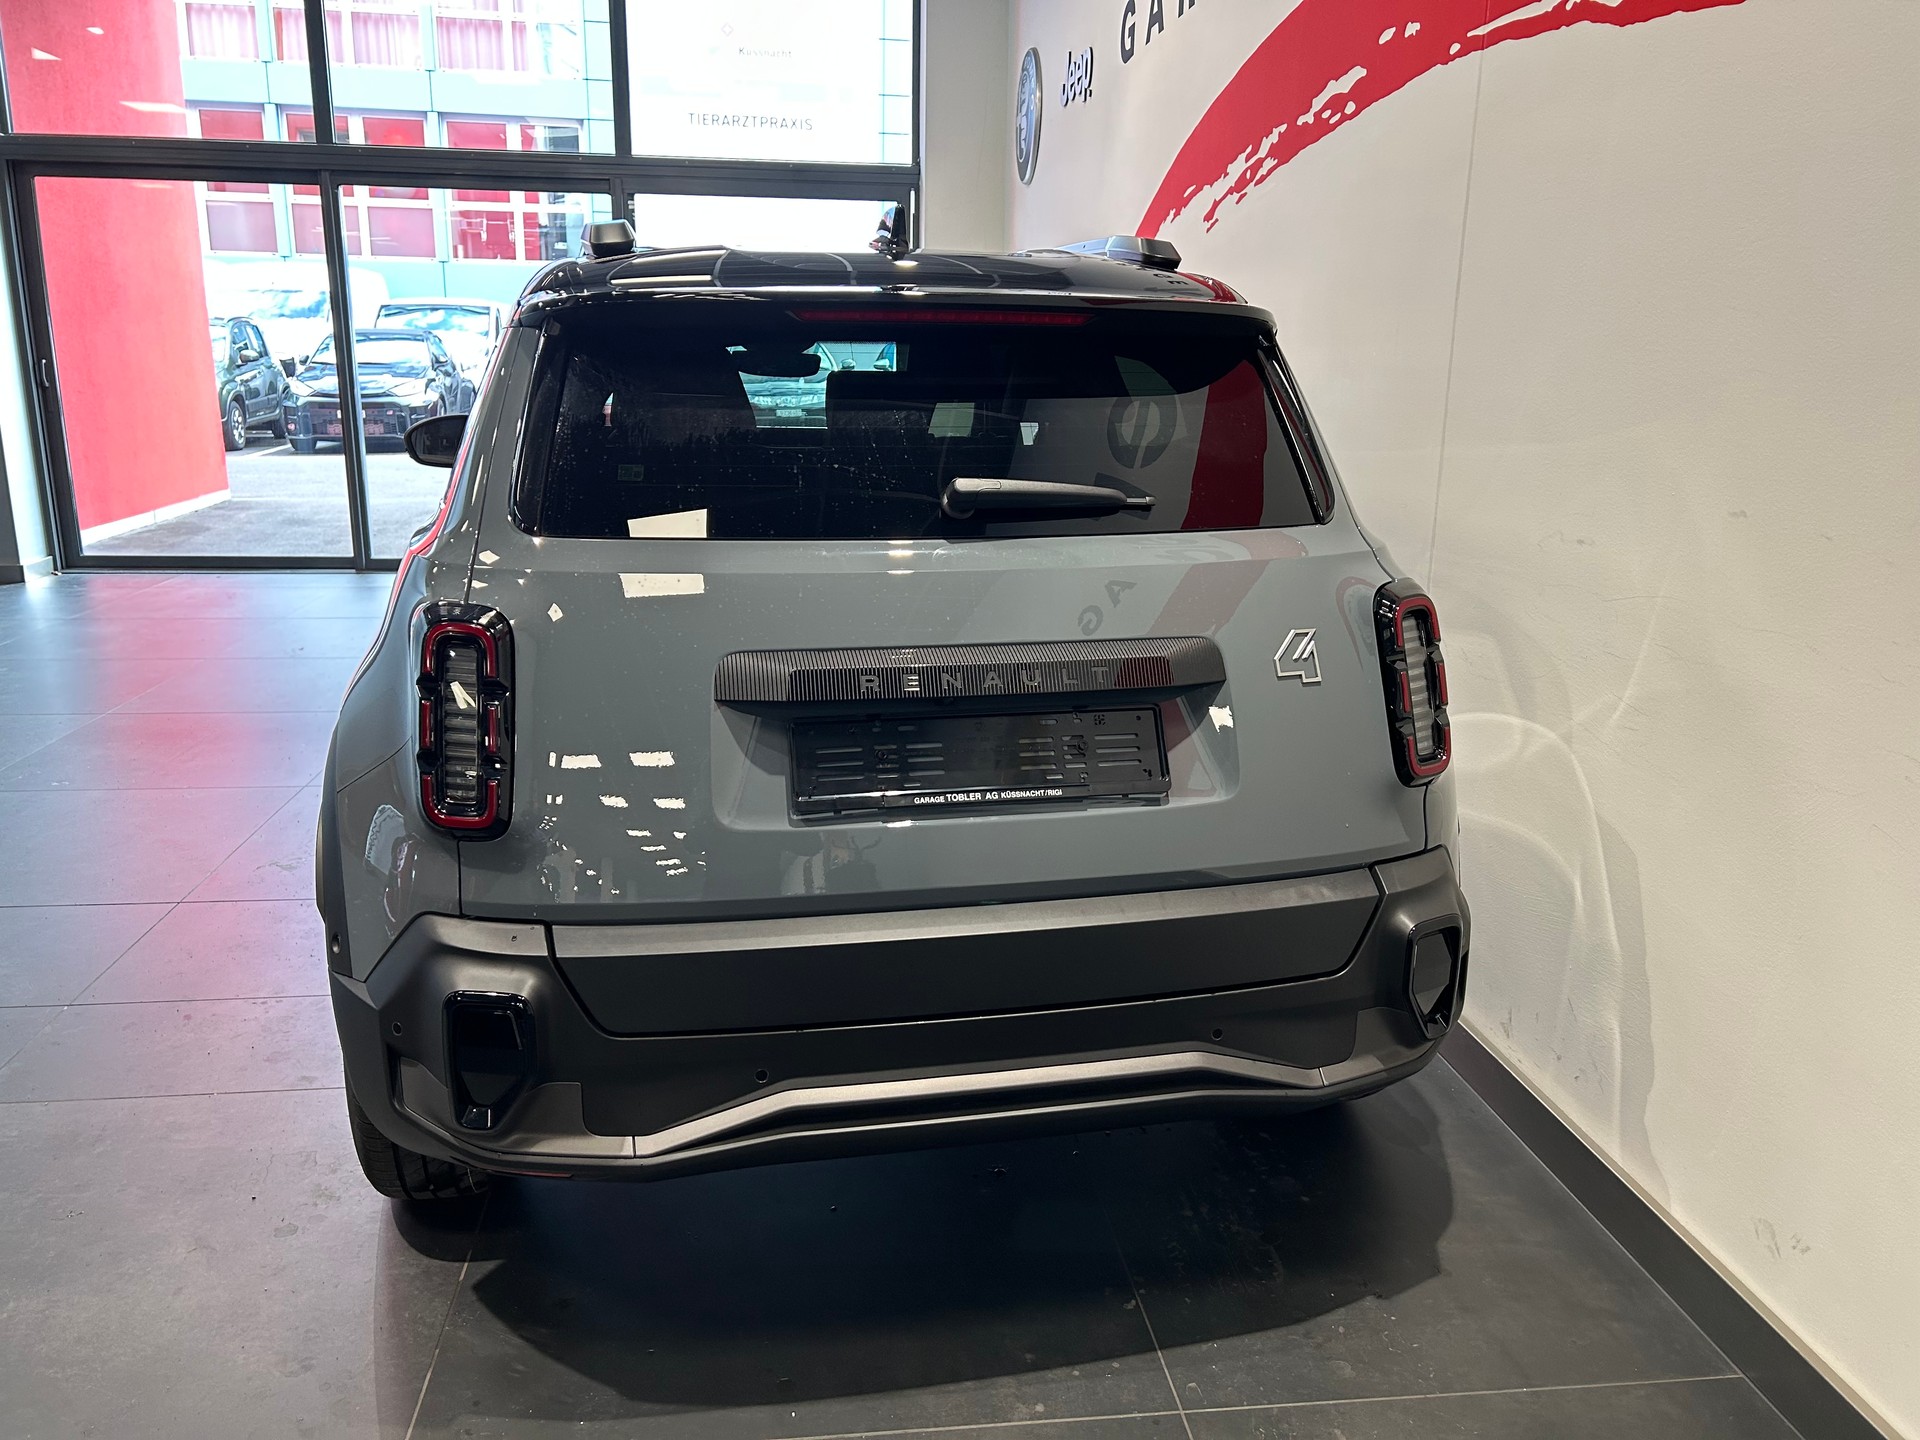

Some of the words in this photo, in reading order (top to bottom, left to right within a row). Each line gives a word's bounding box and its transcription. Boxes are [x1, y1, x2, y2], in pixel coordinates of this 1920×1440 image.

[1121, 0, 1195, 64] GA
[1060, 47, 1093, 107] Jeep
[688, 112, 813, 131] TIERARZTPRAXIS
[860, 666, 1108, 692] RENAULT
[914, 795, 945, 804] GARAGE
[946, 793, 982, 802] TOBLER
[985, 791, 999, 800] AG
[1001, 788, 1063, 799] KÜSSNACHT/RIGI
